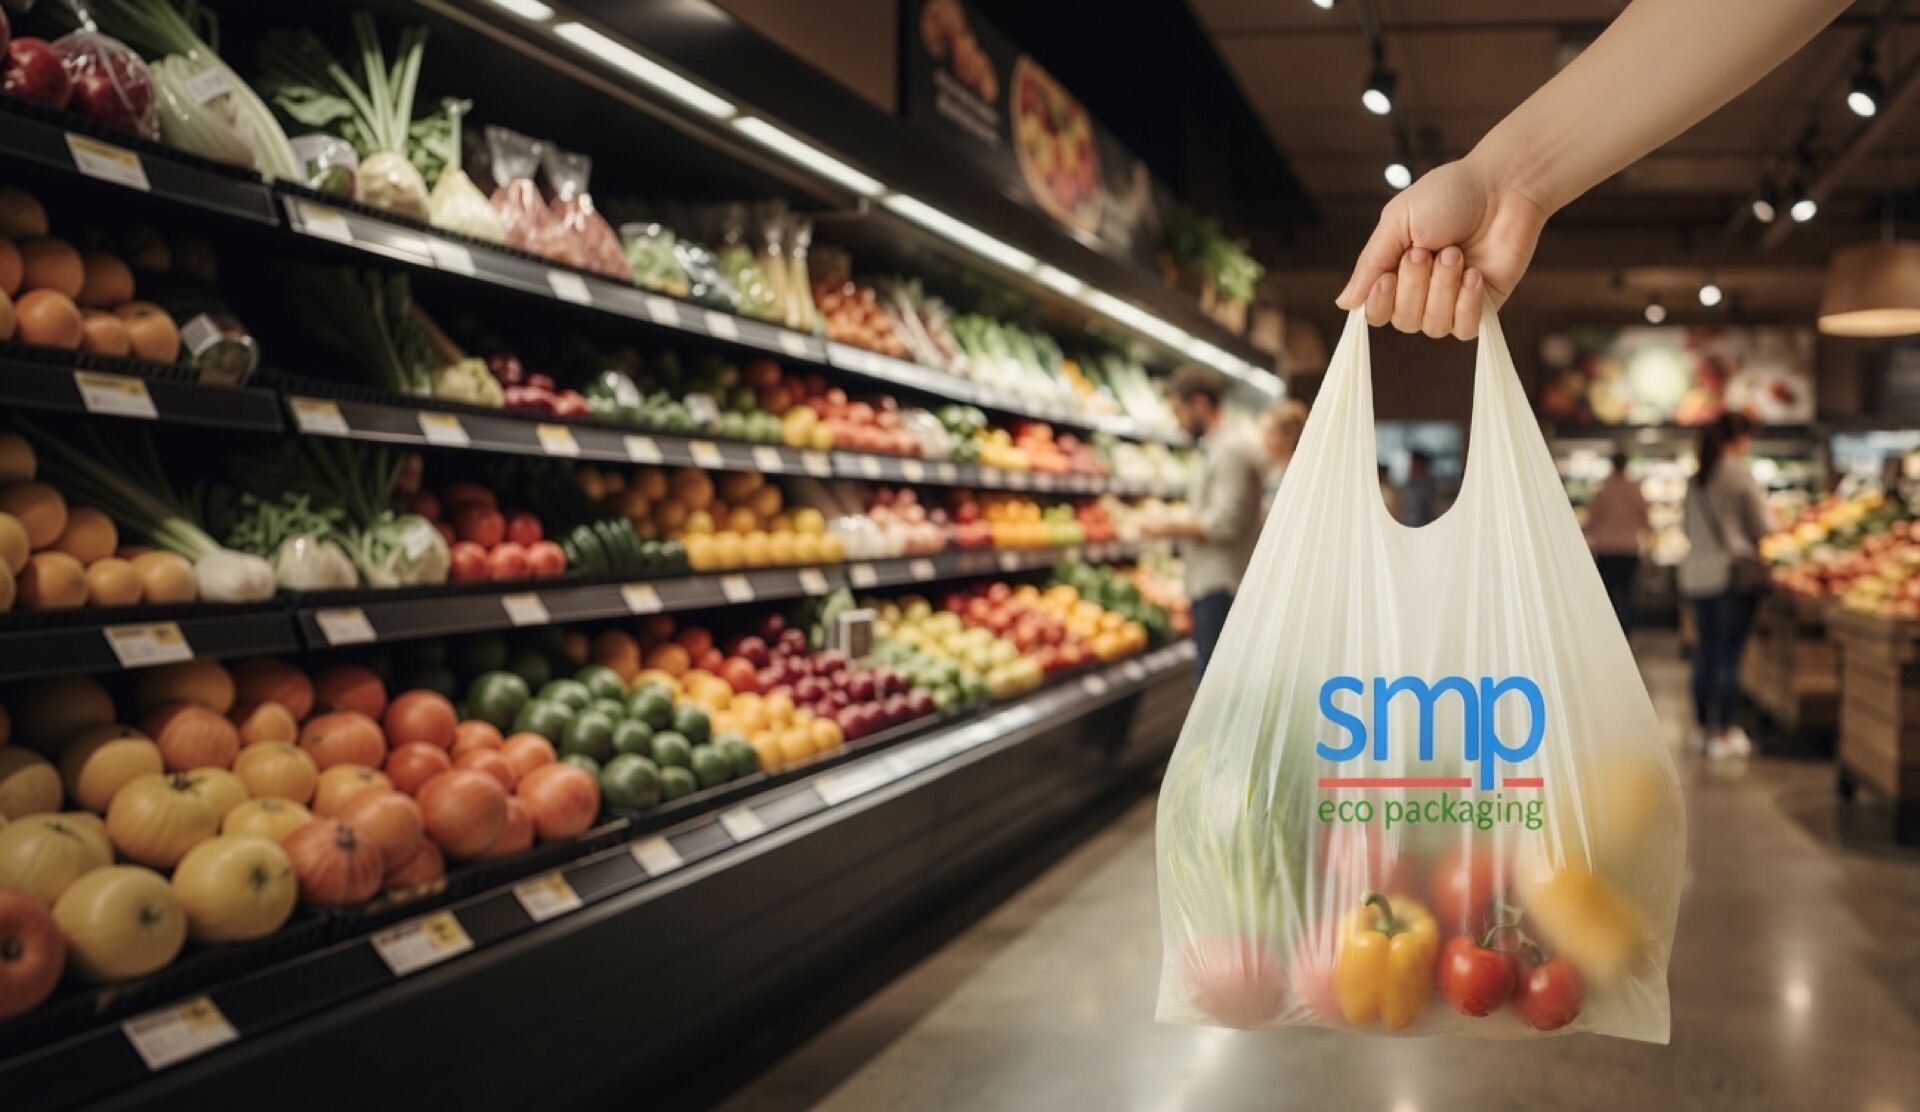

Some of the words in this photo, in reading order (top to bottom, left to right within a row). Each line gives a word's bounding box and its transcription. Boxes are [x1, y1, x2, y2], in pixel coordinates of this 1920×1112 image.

[1316, 676, 1546, 791] smp
[1317, 800, 1374, 823] eco
[1384, 792, 1544, 830] packaging
